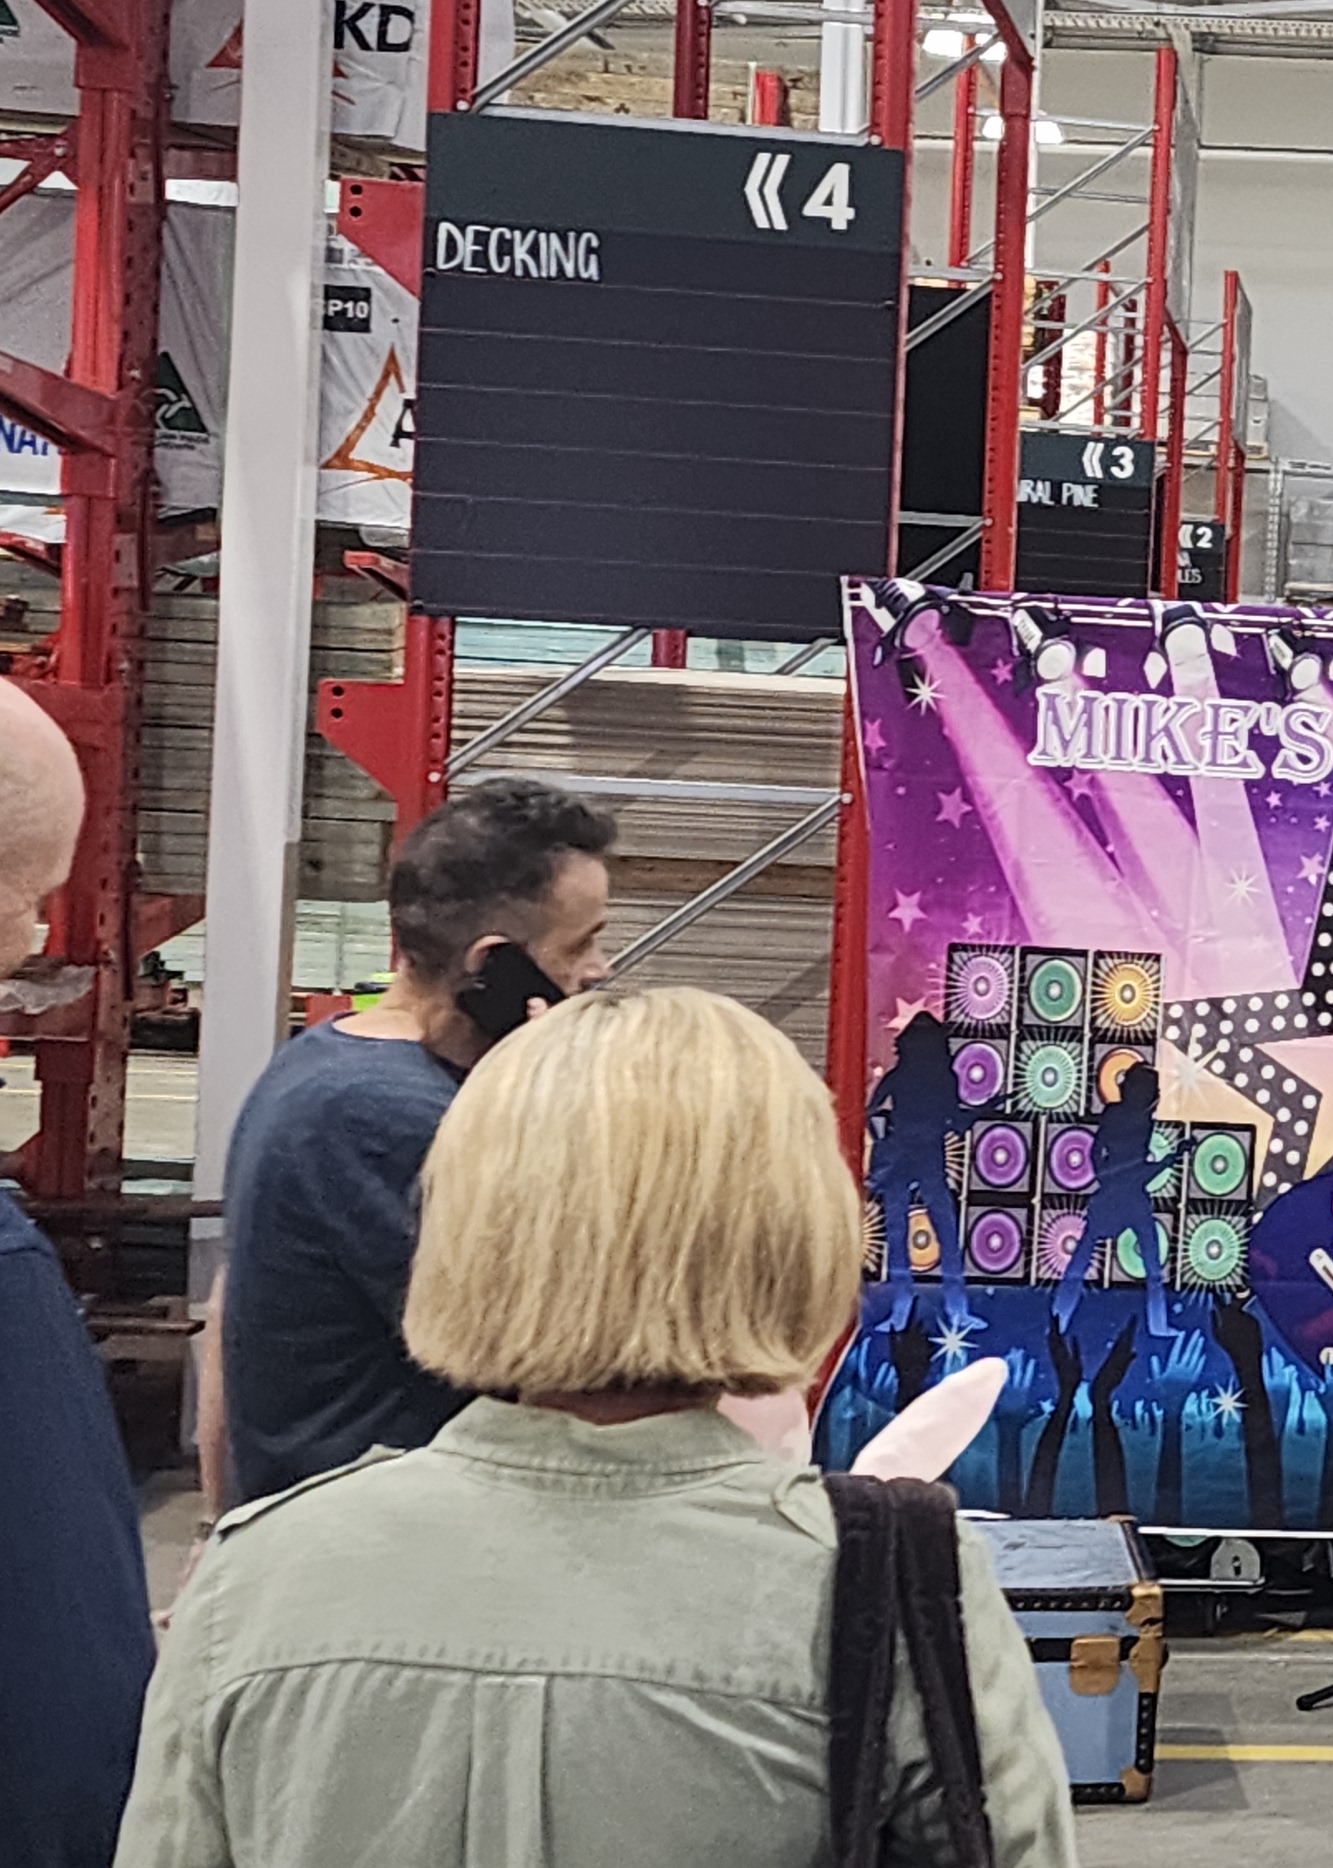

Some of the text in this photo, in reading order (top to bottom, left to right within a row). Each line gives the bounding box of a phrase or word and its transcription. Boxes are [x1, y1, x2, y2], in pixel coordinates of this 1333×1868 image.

[802, 163, 856, 230] 4
[436, 221, 600, 280] DECKING
[1110, 446, 1135, 478] 3
[1017, 479, 1055, 506] RAL
[1196, 528, 1213, 548] 2
